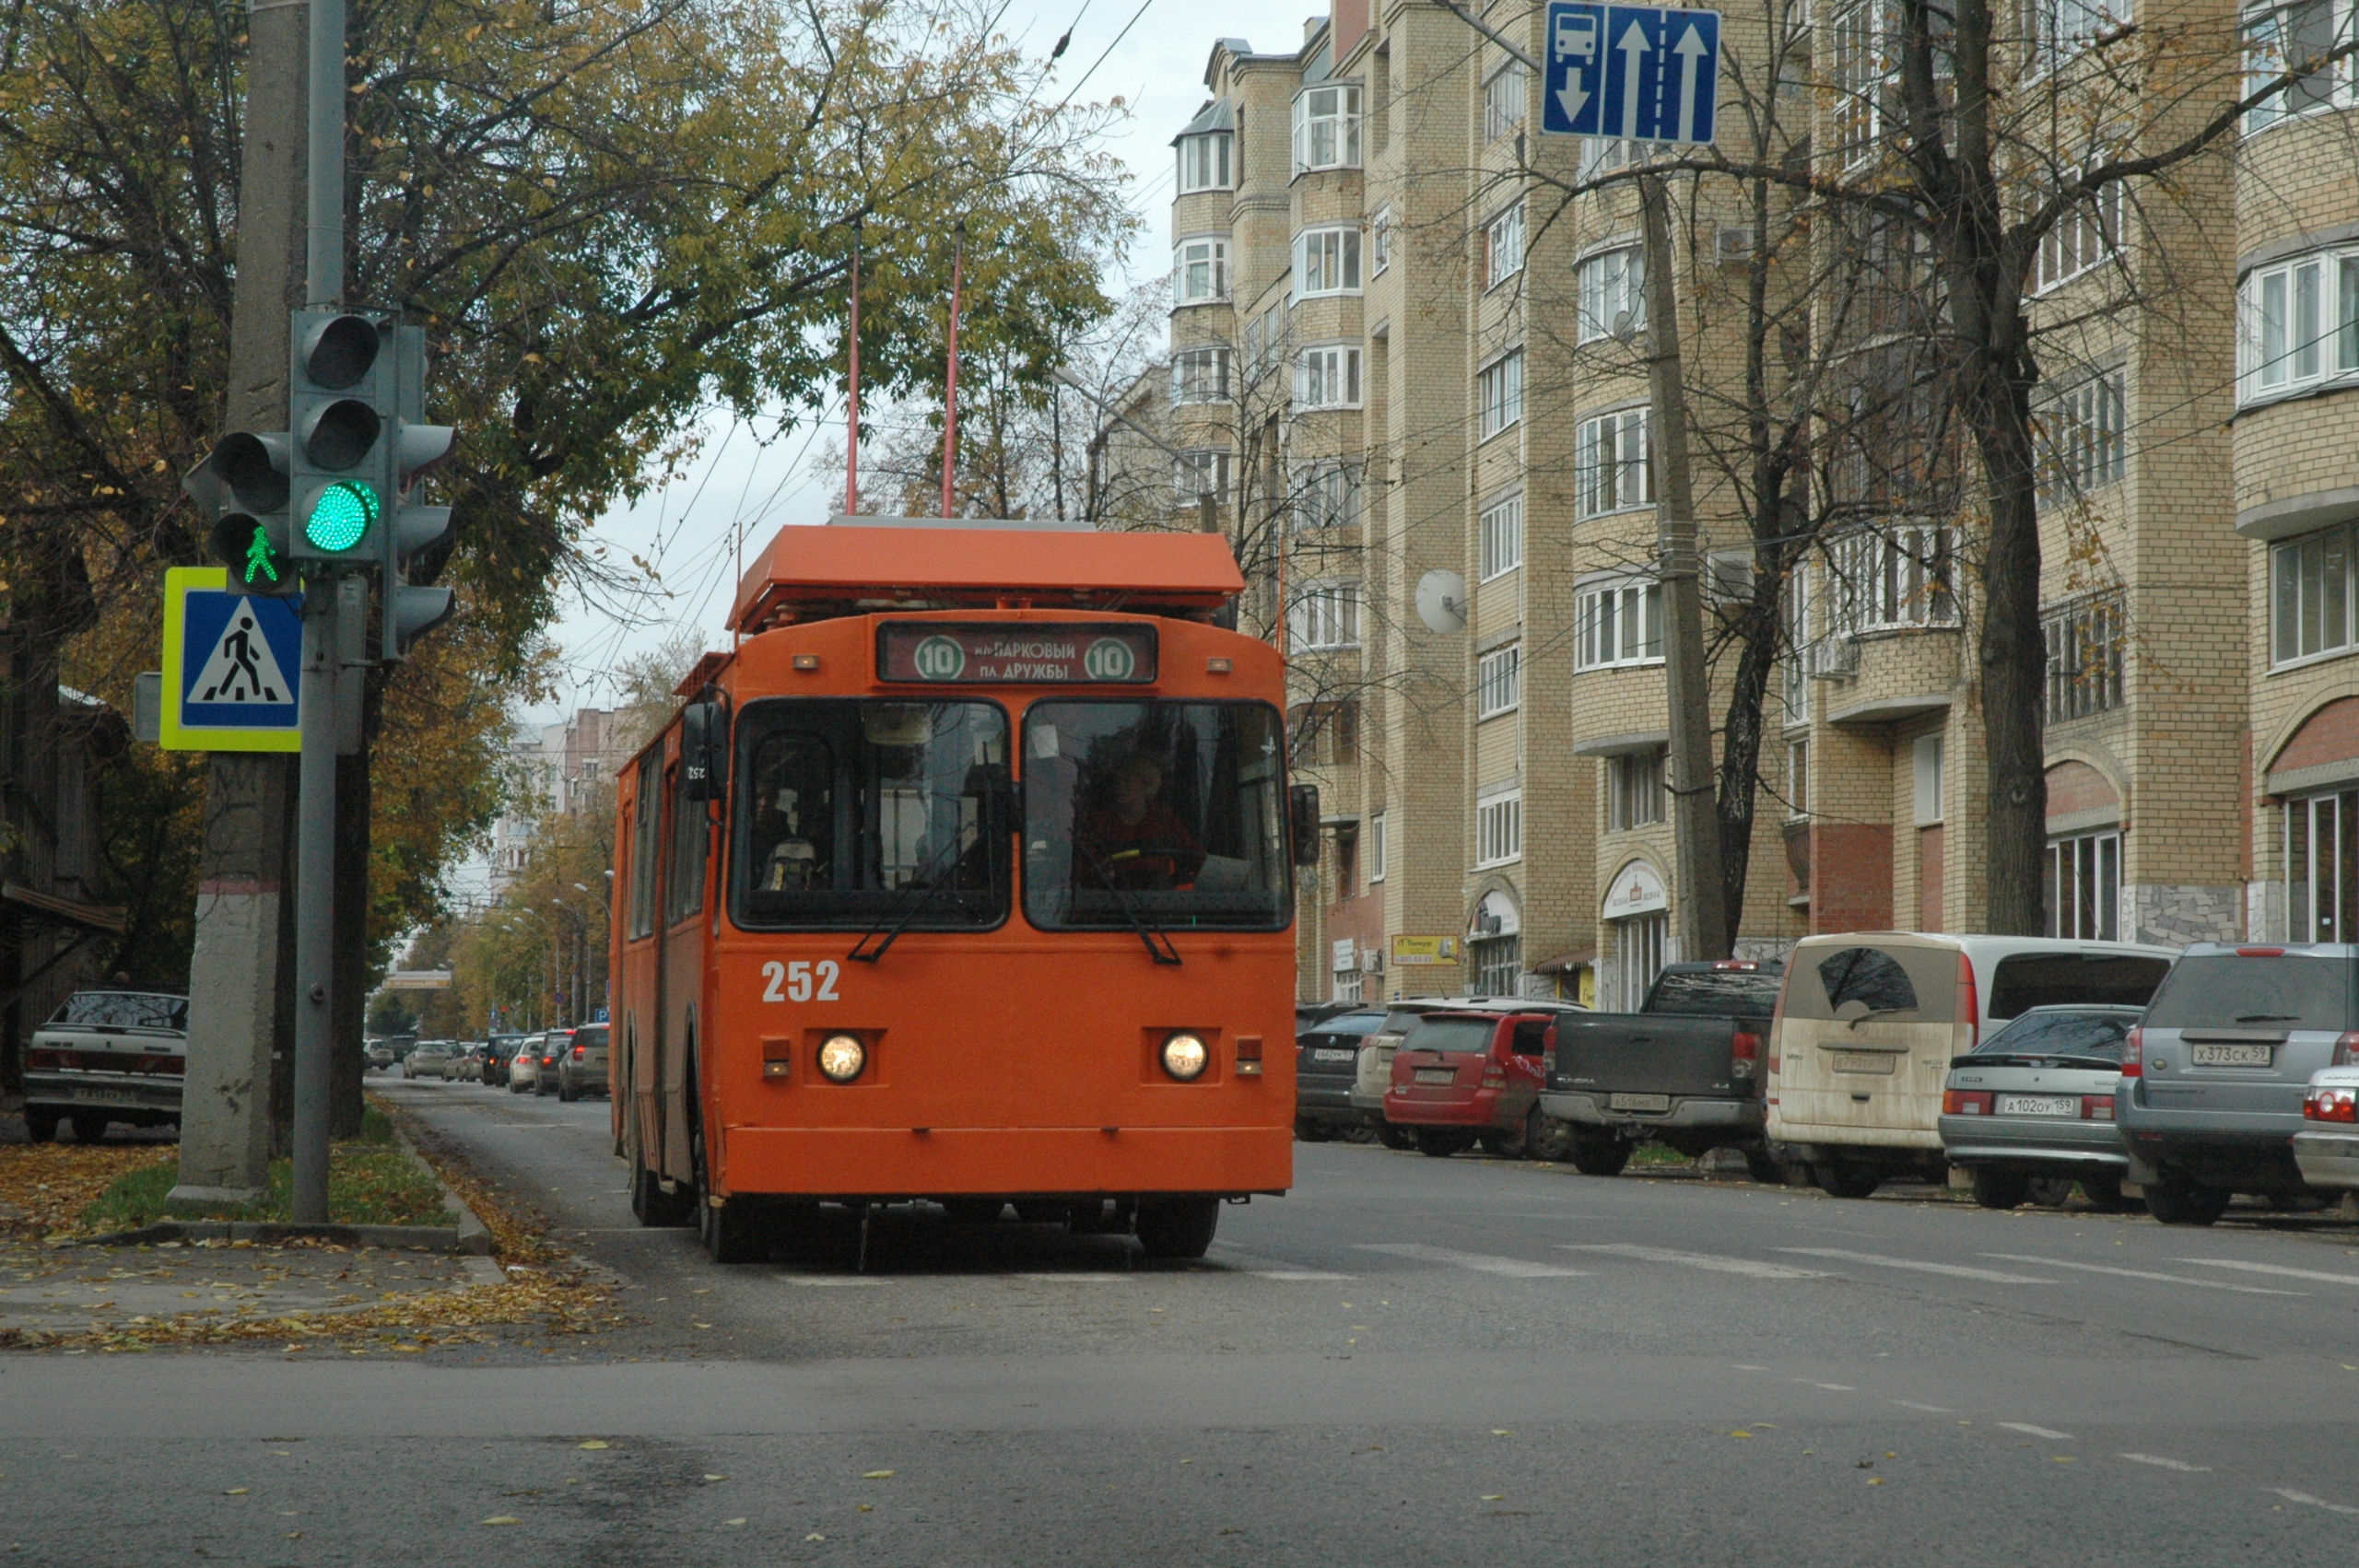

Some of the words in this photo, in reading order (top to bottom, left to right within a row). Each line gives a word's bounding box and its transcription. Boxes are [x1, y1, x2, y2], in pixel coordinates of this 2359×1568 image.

[924, 645, 955, 673] 10
[994, 642, 1075, 659] ПАРКОВЫЙ
[1094, 647, 1122, 675] 10
[1003, 663, 1068, 679] ДРУЖБЫ
[761, 960, 839, 1001] 252
[599, 1011, 608, 1021] P
[2252, 1047, 2266, 1059] 59
[2007, 1100, 2051, 1113] А102ОУ
[2055, 1100, 2071, 1110] 159
